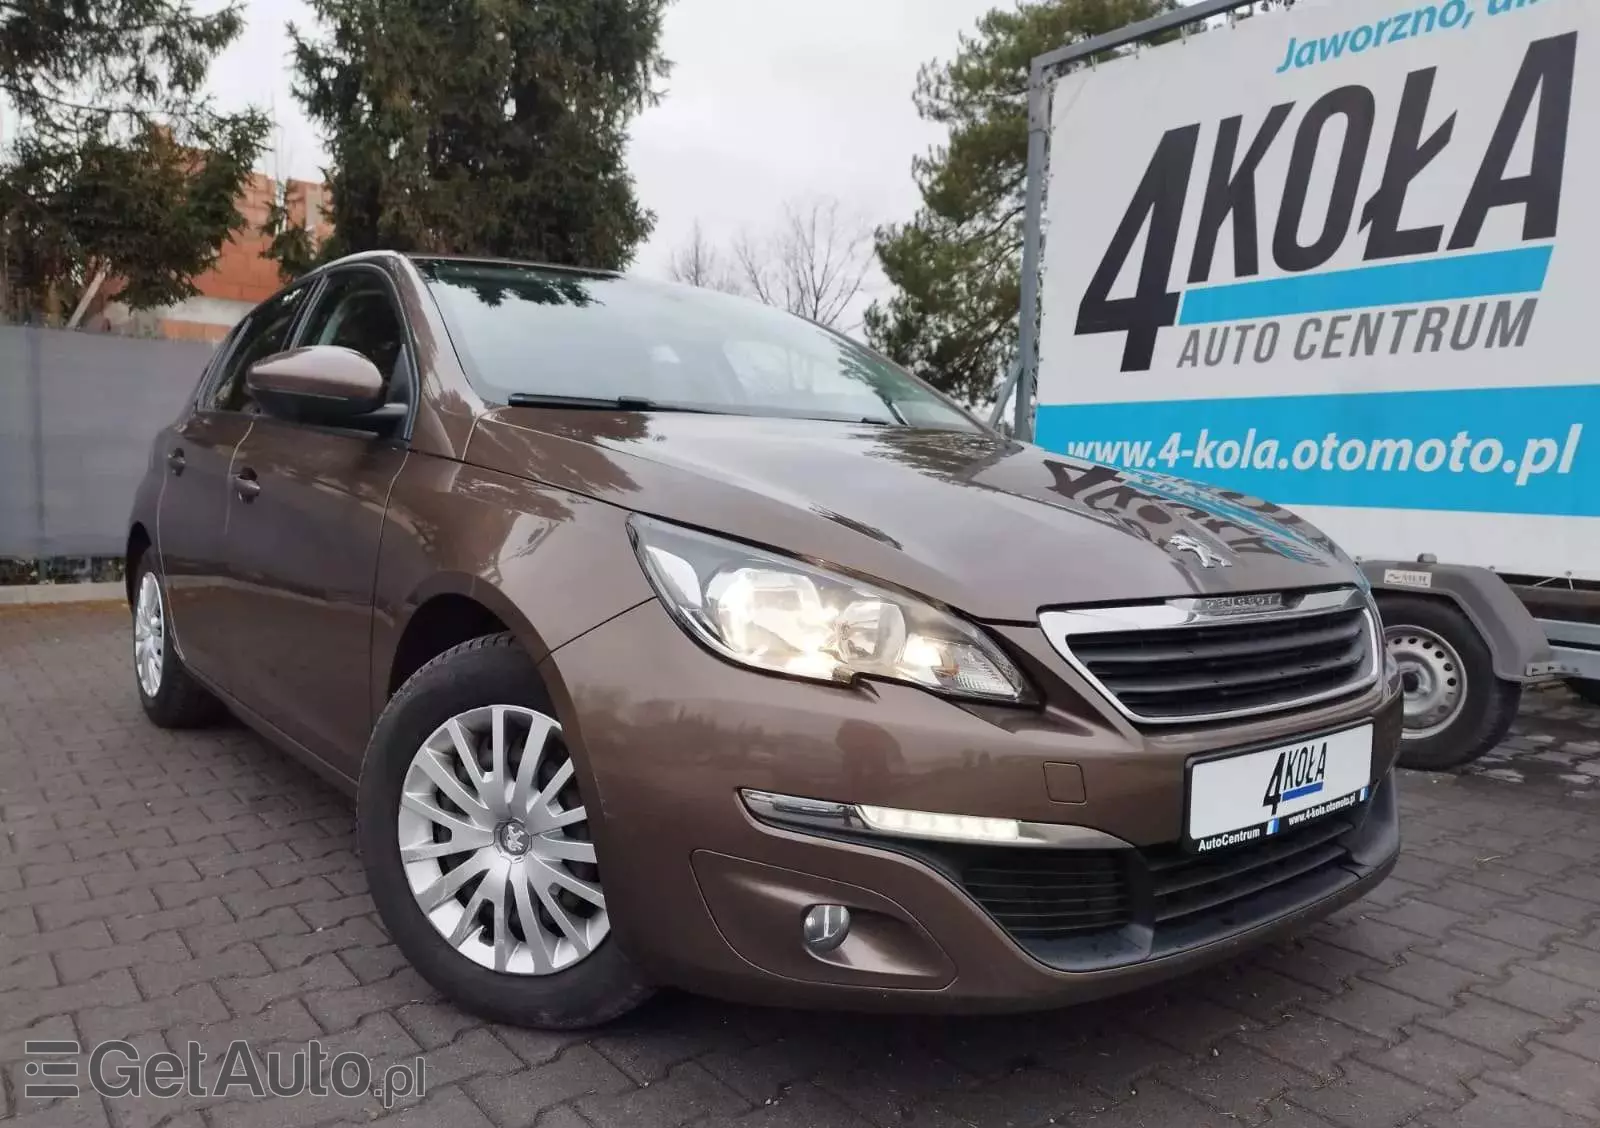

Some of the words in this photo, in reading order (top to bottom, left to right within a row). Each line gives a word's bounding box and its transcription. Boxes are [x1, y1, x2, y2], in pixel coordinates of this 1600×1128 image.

[1275, 0, 1474, 74] Jaworzno,
[1177, 321, 1281, 368] AUTO
[1293, 298, 1538, 361] CENTRUM
[1067, 424, 1584, 487] www.4-kola.otomoto.pl
[1198, 828, 1261, 852] AutoCentrum
[1288, 793, 1356, 826] www.4-kola.otomoto.pl
